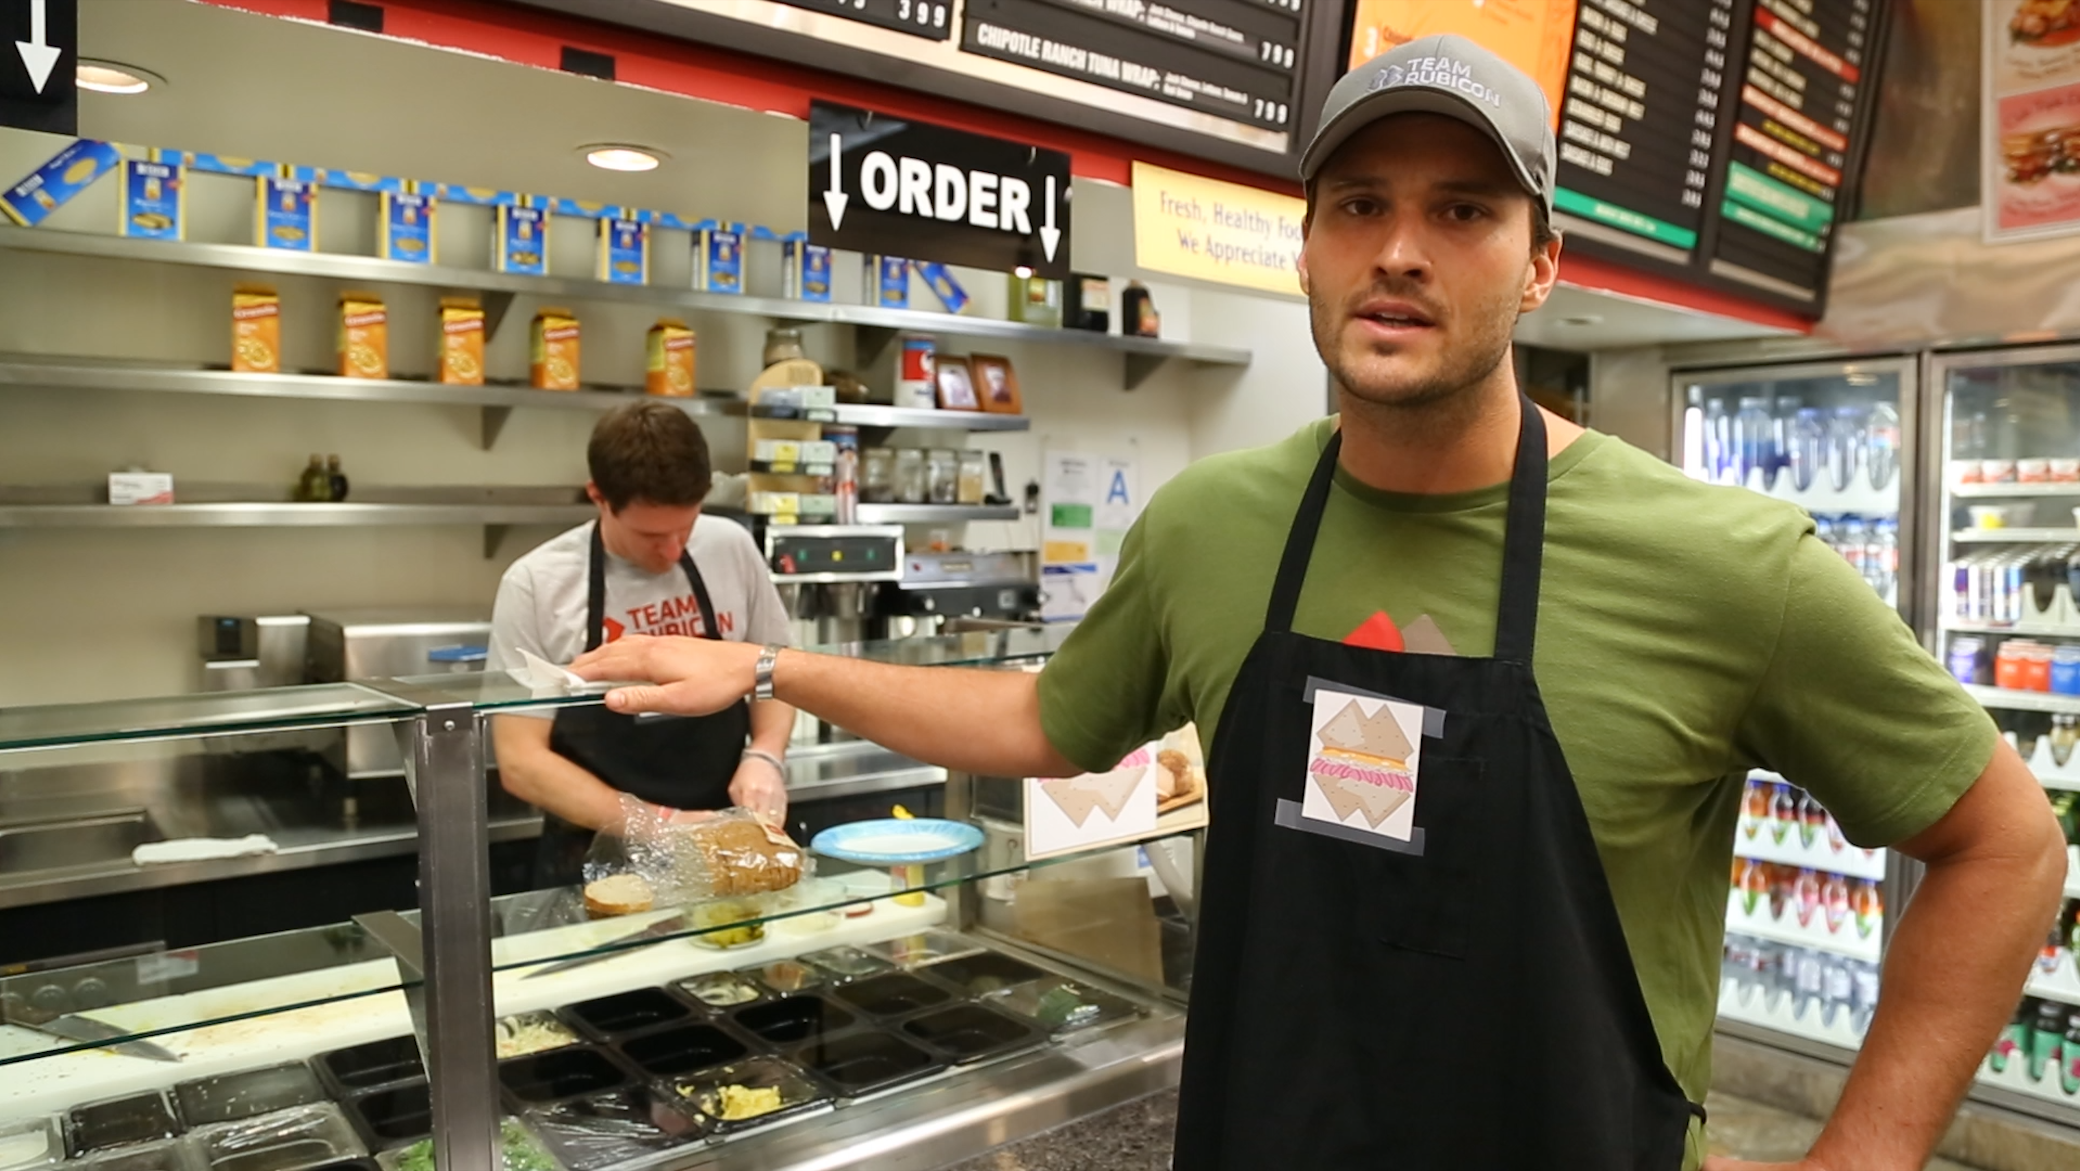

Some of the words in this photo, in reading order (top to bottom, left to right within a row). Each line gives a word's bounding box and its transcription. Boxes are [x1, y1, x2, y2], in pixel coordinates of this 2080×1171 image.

[977, 22, 1041, 59] CHIPOTLE
[1041, 41, 1087, 74] RANCH
[1087, 52, 1121, 81] TUNA
[1121, 61, 1161, 91] WRAP:
[1407, 57, 1472, 78] TEAM
[1404, 70, 1500, 108] RUBICON
[860, 151, 1032, 234] ORDER
[1159, 190, 1207, 224] Fresh,
[1213, 202, 1272, 241] Healthy
[1177, 228, 1199, 254] We
[1206, 234, 1286, 268] Appreciate
[1107, 469, 1129, 505] A
[626, 594, 698, 629] TEAM
